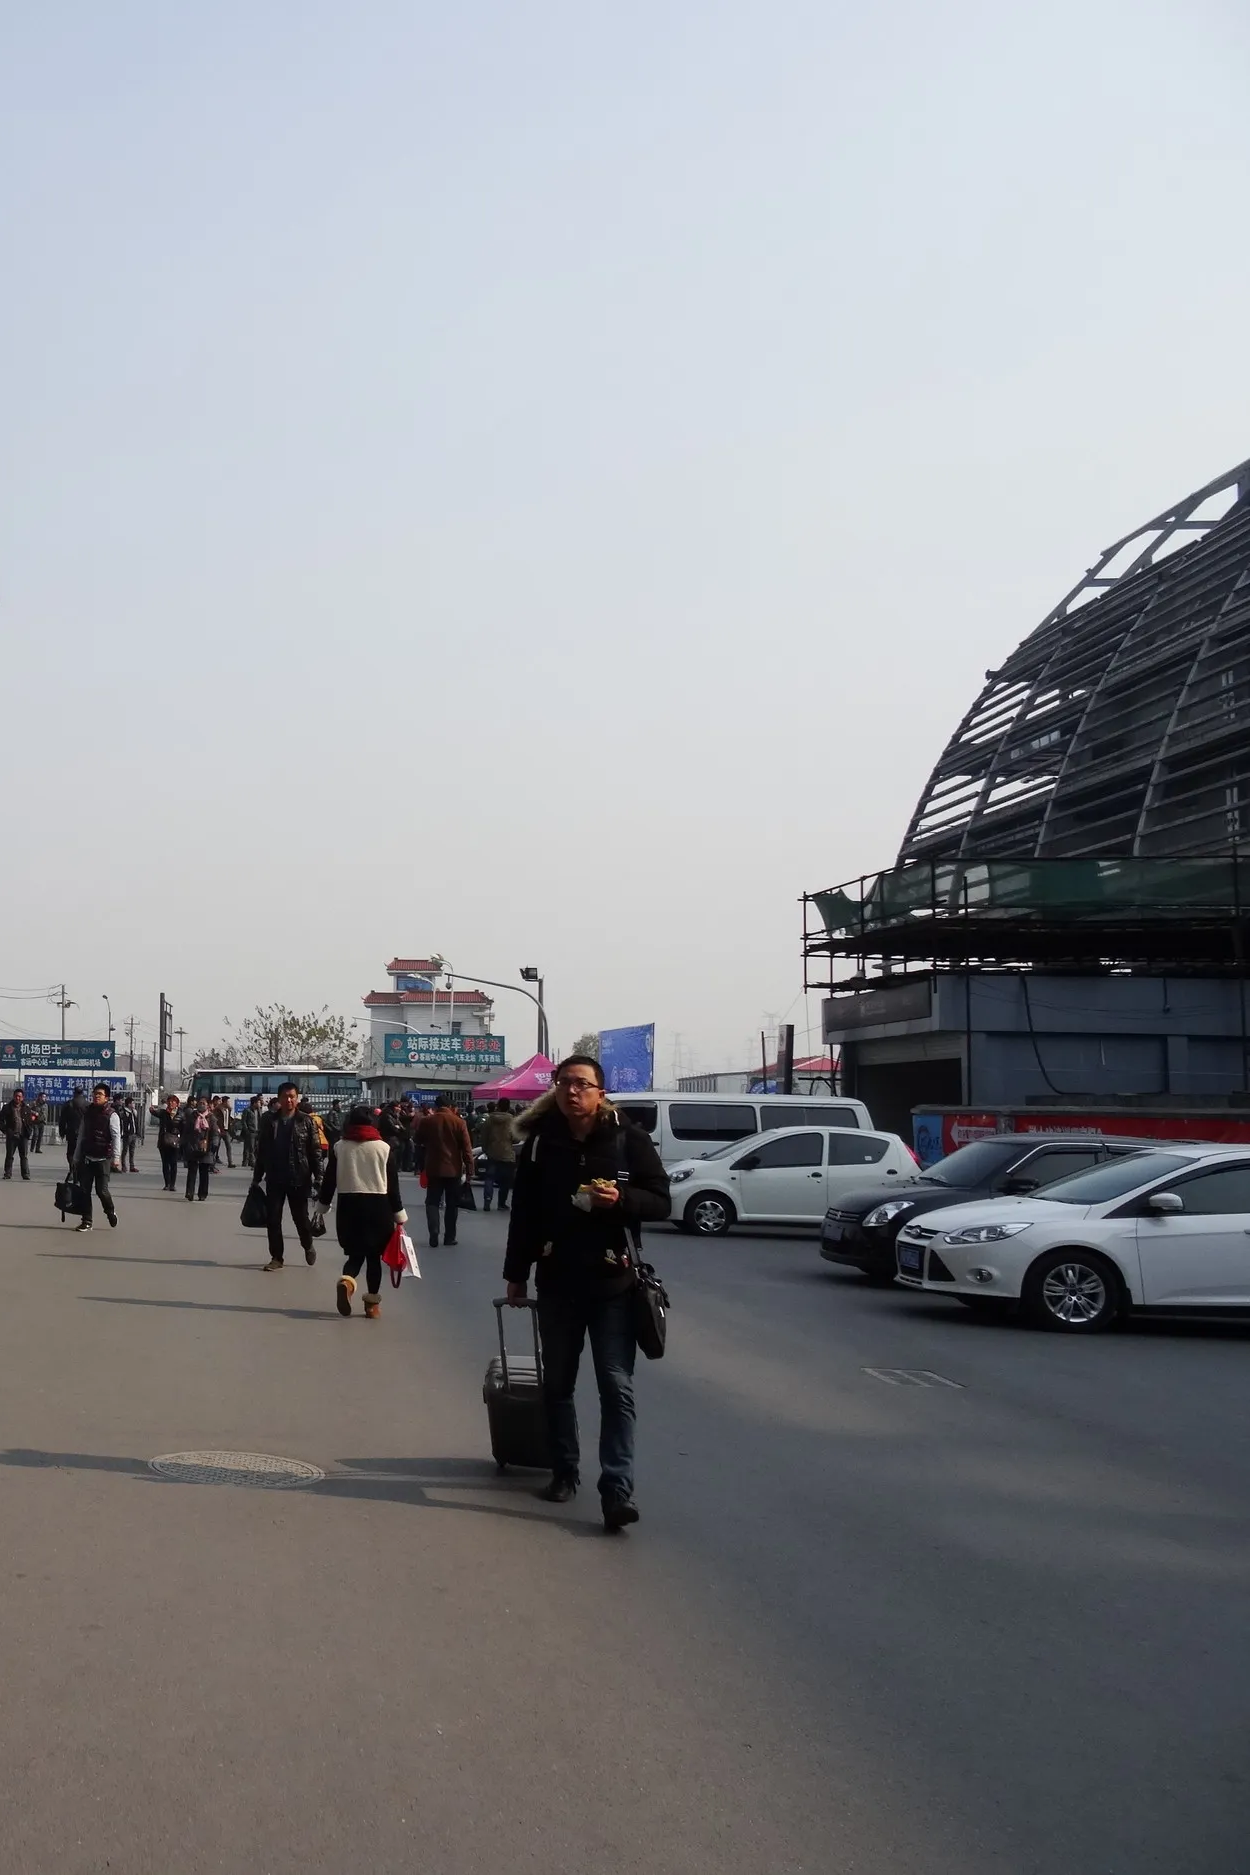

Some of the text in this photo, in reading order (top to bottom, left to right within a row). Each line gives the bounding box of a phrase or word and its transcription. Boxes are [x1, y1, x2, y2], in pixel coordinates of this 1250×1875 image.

[20, 1043, 62, 1055] 机场巴士
[407, 1037, 501, 1052] 站际接送车 候车处
[478, 1054, 501, 1063] 汽车西站
[27, 1077, 62, 1088] 汽车西站
